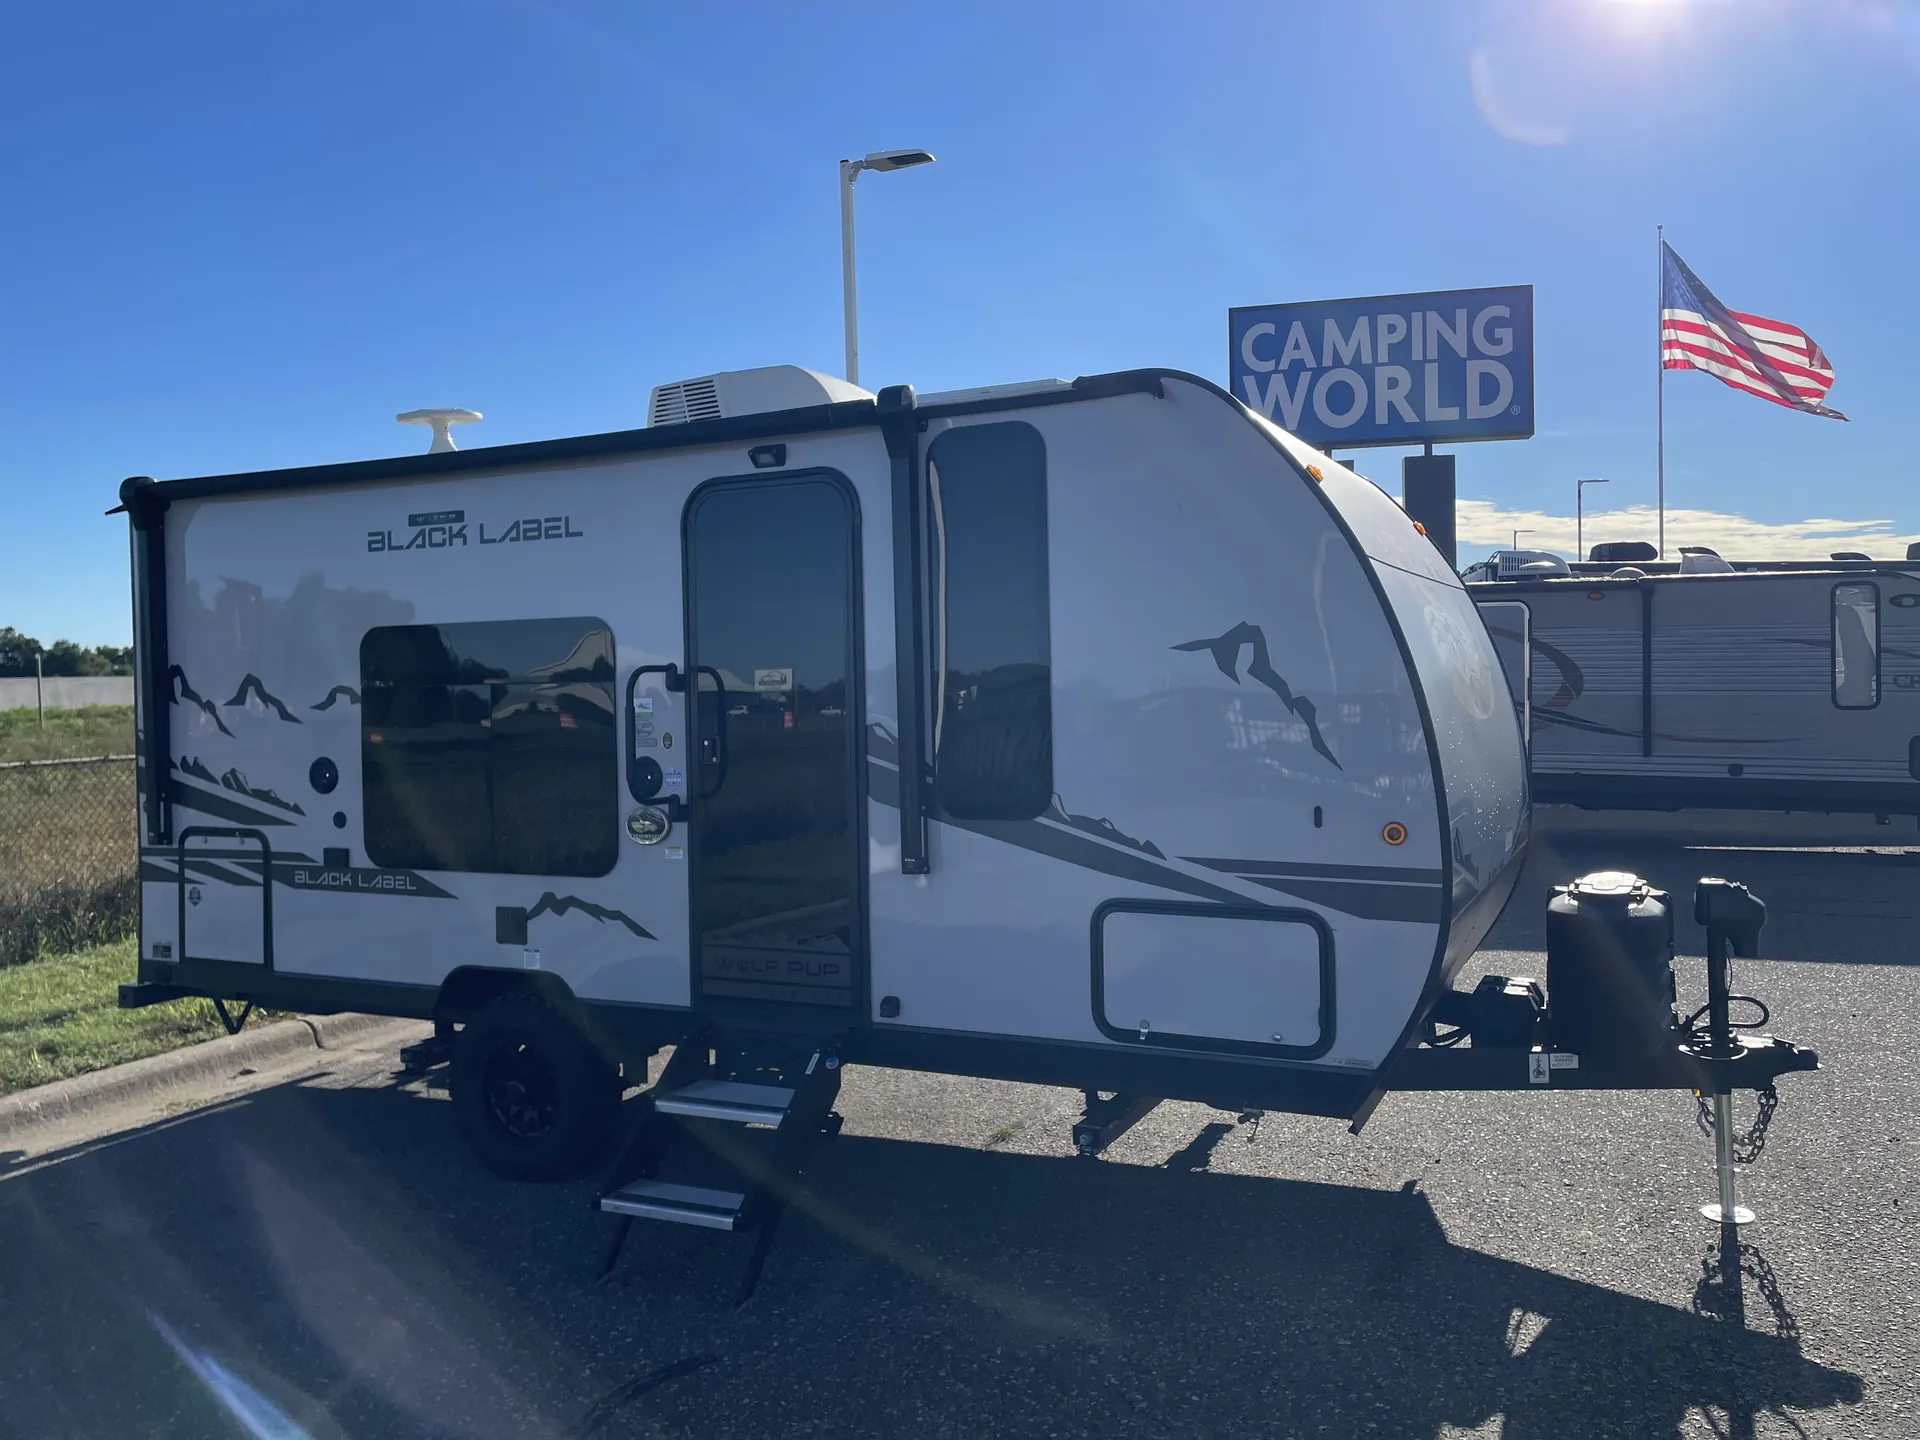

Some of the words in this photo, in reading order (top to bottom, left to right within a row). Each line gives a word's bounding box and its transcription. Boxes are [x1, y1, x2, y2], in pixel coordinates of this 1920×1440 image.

[1241, 304, 1514, 373] CAMPING
[1242, 359, 1514, 431] WORLD
[367, 524, 468, 552] BLACK
[479, 516, 584, 545] LABEL
[294, 870, 352, 886] BLACK
[358, 873, 417, 890] LABEL
[787, 960, 840, 977] PUP
